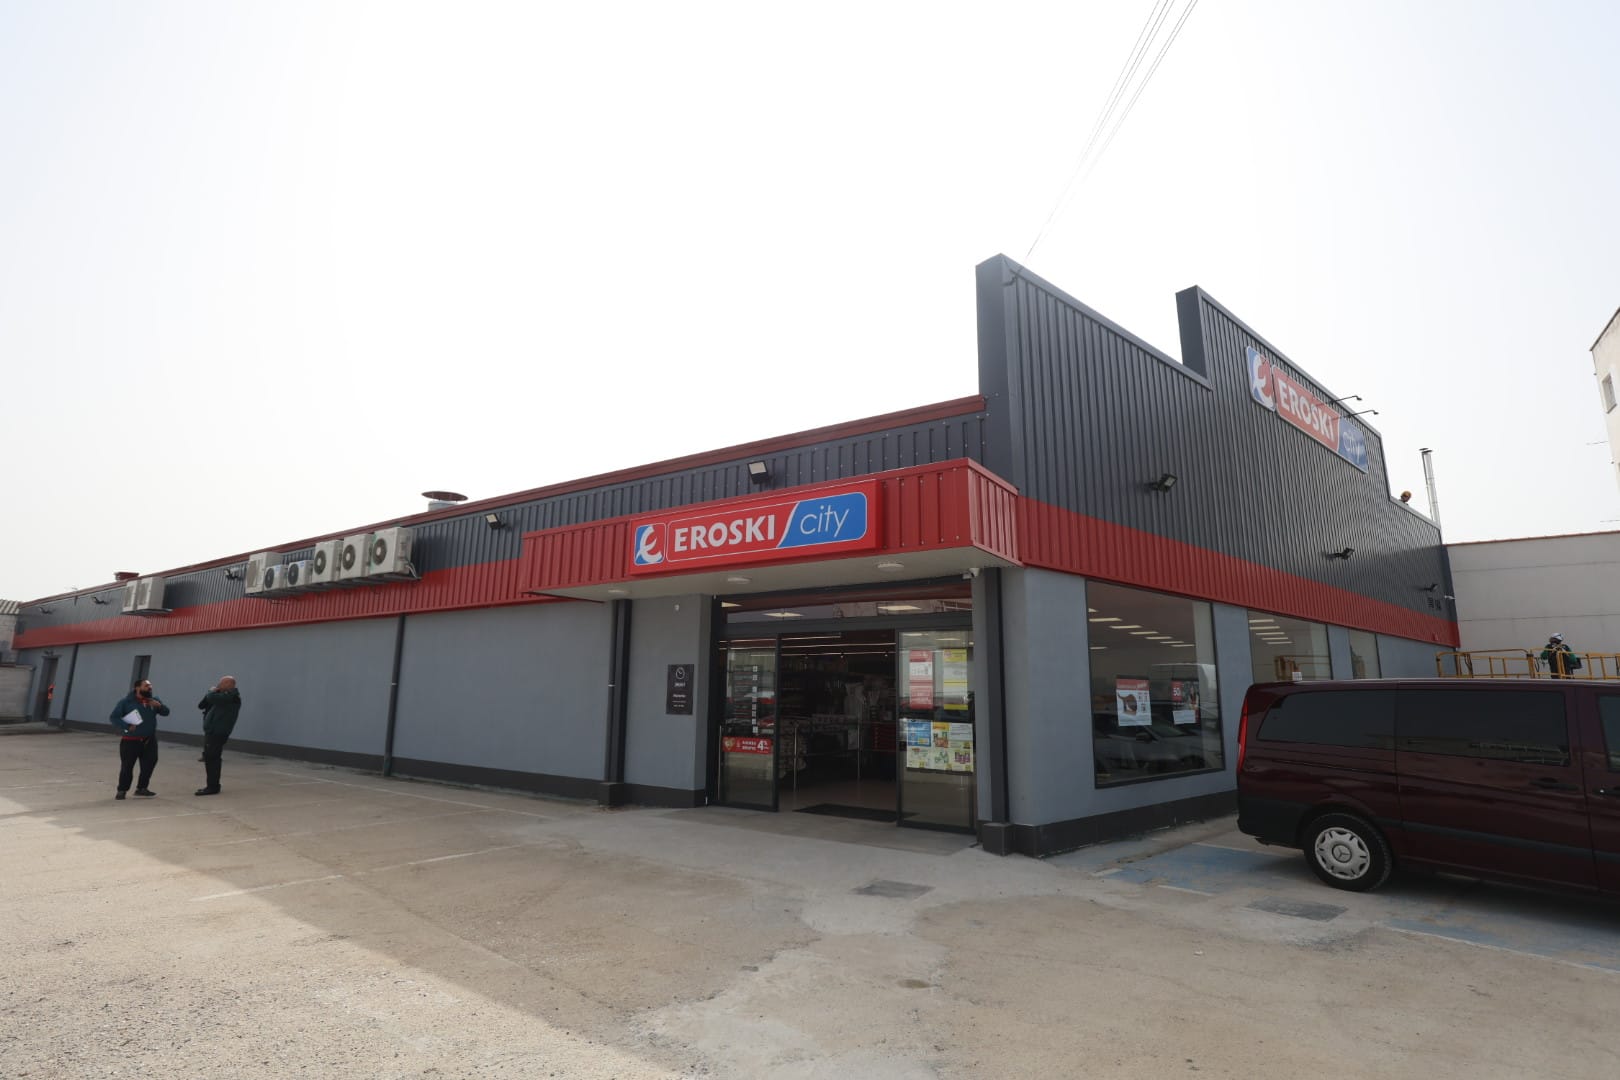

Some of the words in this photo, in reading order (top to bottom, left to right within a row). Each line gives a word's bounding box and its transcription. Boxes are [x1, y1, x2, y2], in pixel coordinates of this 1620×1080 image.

[1278, 379, 1335, 442] EROSKI
[674, 514, 775, 552] EROSKI
[800, 504, 850, 537] city
